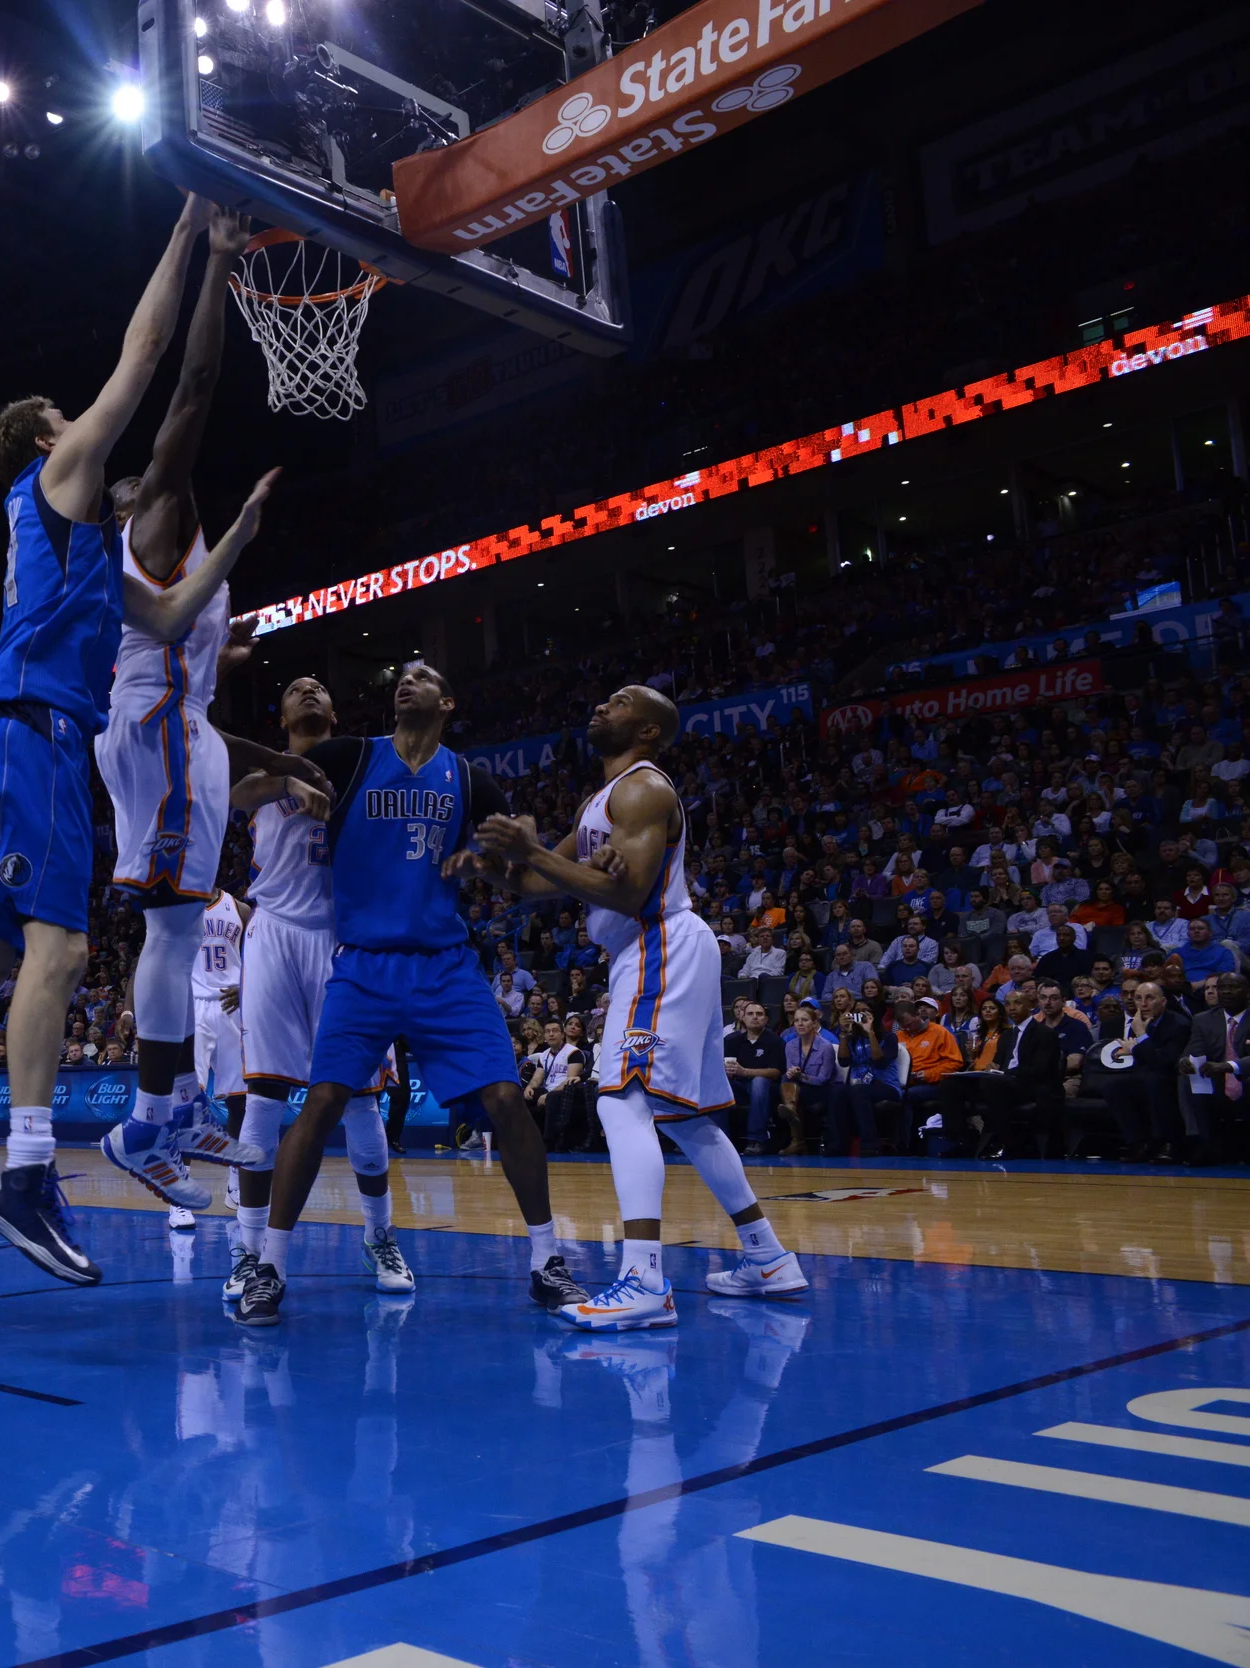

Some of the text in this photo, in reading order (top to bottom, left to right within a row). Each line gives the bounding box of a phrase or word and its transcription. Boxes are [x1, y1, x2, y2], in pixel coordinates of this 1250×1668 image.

[554, 257, 567, 272] NBA
[662, 182, 849, 352] OKC
[1110, 334, 1210, 377] devon
[635, 491, 697, 522] devon
[303, 578, 385, 622] NEVER
[389, 545, 477, 597] STOPS.
[780, 686, 811, 704] 115
[947, 681, 1031, 714] Home
[1039, 667, 1094, 697] Life
[686, 700, 776, 733] CITY
[365, 788, 455, 823] DALLAS
[405, 822, 447, 866] 34
[203, 918, 241, 944] NDER
[201, 944, 228, 972] 15
[620, 1034, 653, 1050] OKC
[90, 1093, 133, 1105] LIGHT
[97, 1082, 126, 1094] BUD
